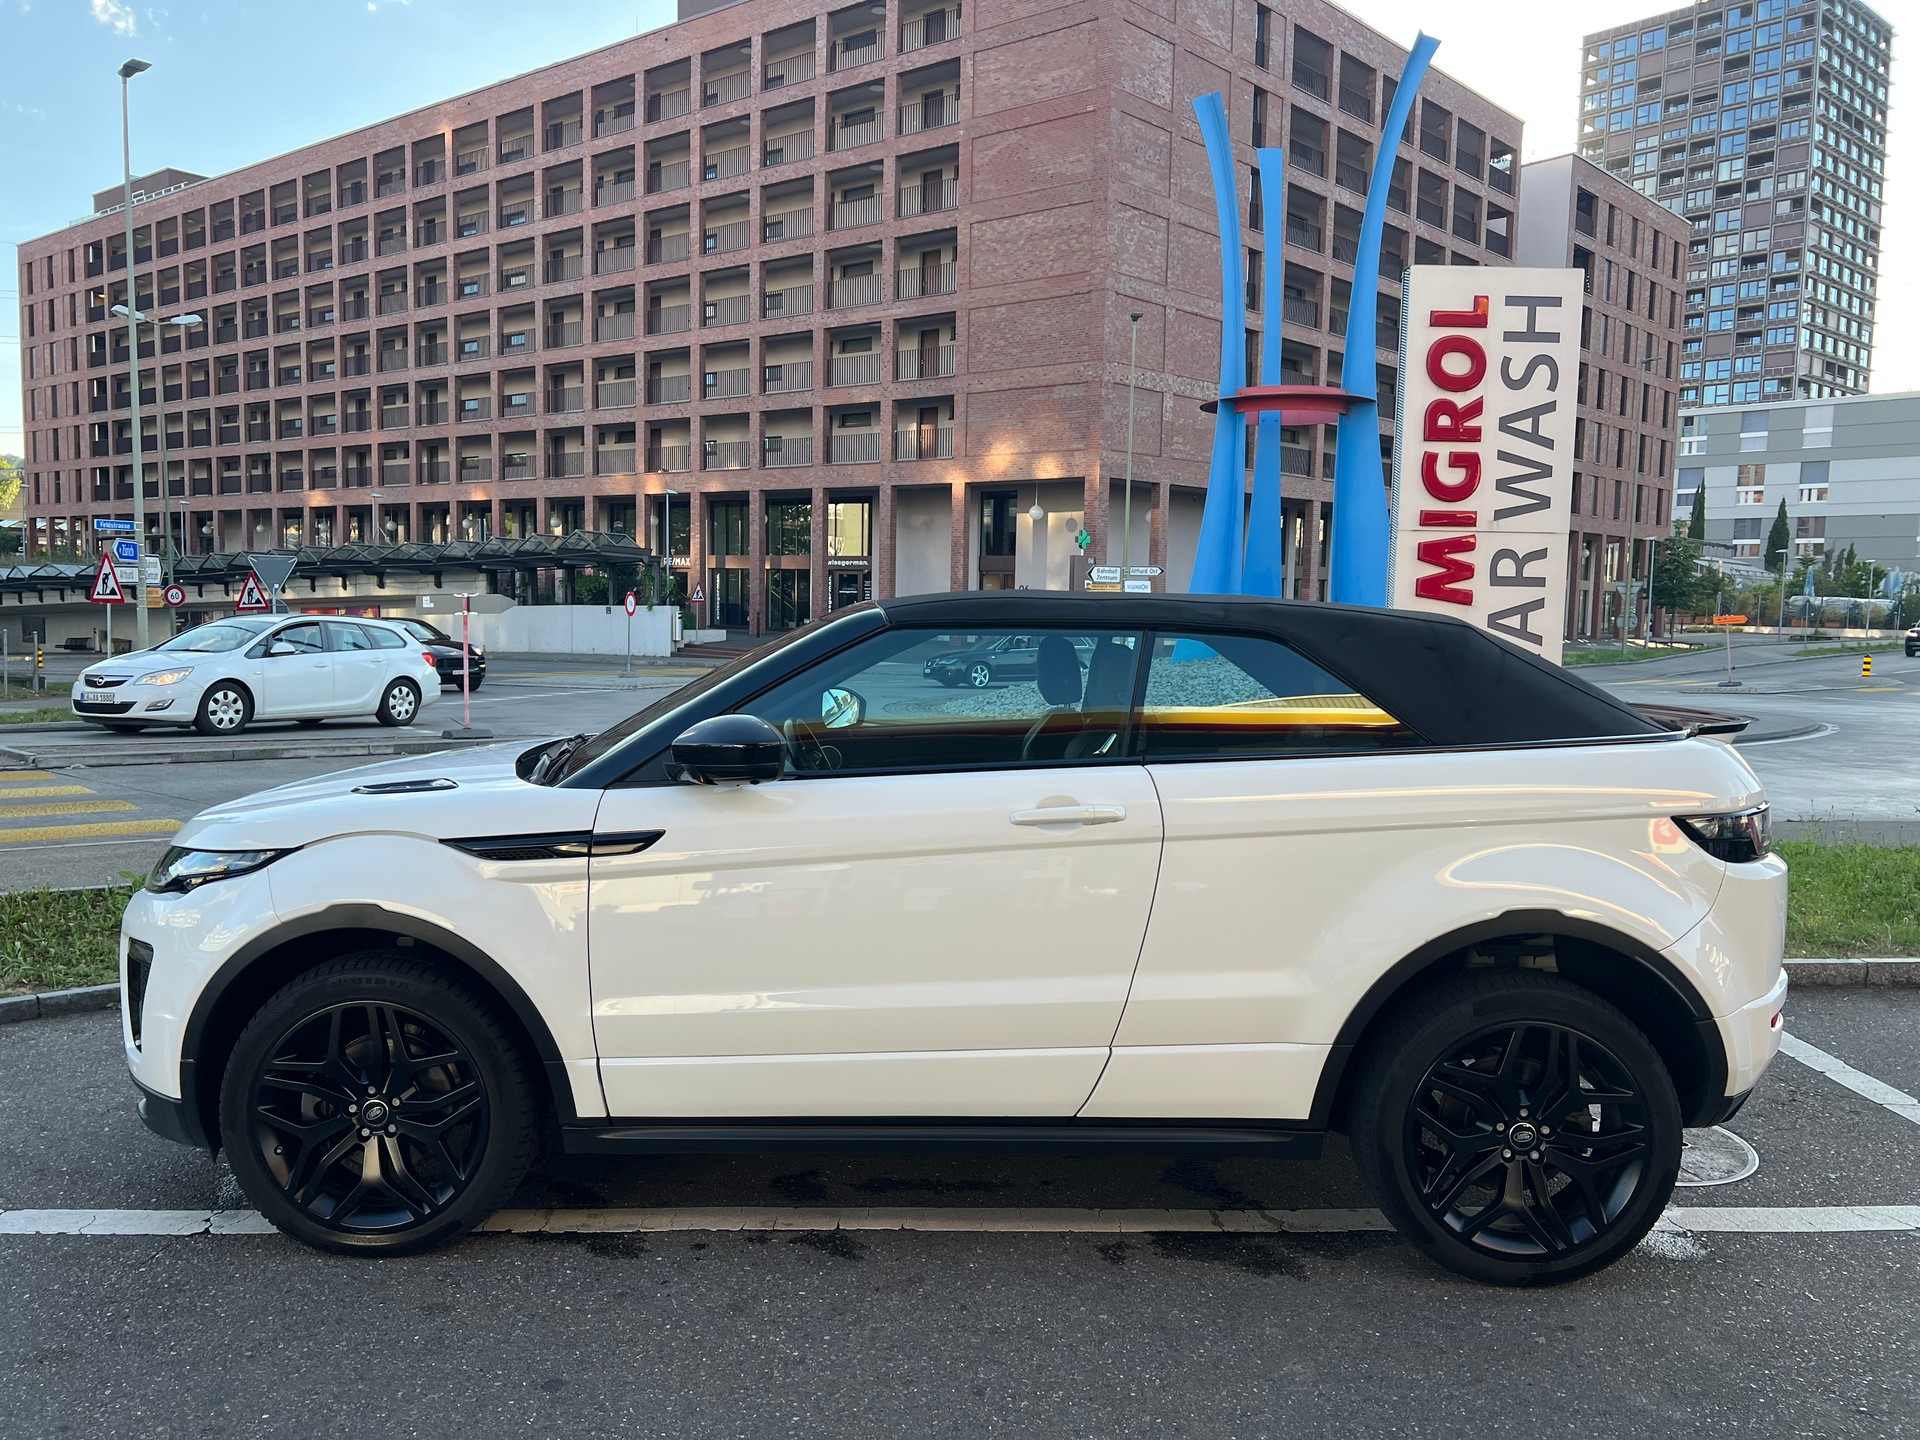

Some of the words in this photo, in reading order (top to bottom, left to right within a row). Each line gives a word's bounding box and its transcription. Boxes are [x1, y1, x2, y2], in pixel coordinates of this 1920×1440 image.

[1493, 295, 1563, 522] WASH
[1415, 295, 1489, 606] MIGROL
[100, 521, 131, 530] Feldstrasse
[170, 592, 180, 600] 60
[1096, 567, 1118, 575] Bahnhof
[1487, 546, 1548, 655] AR
